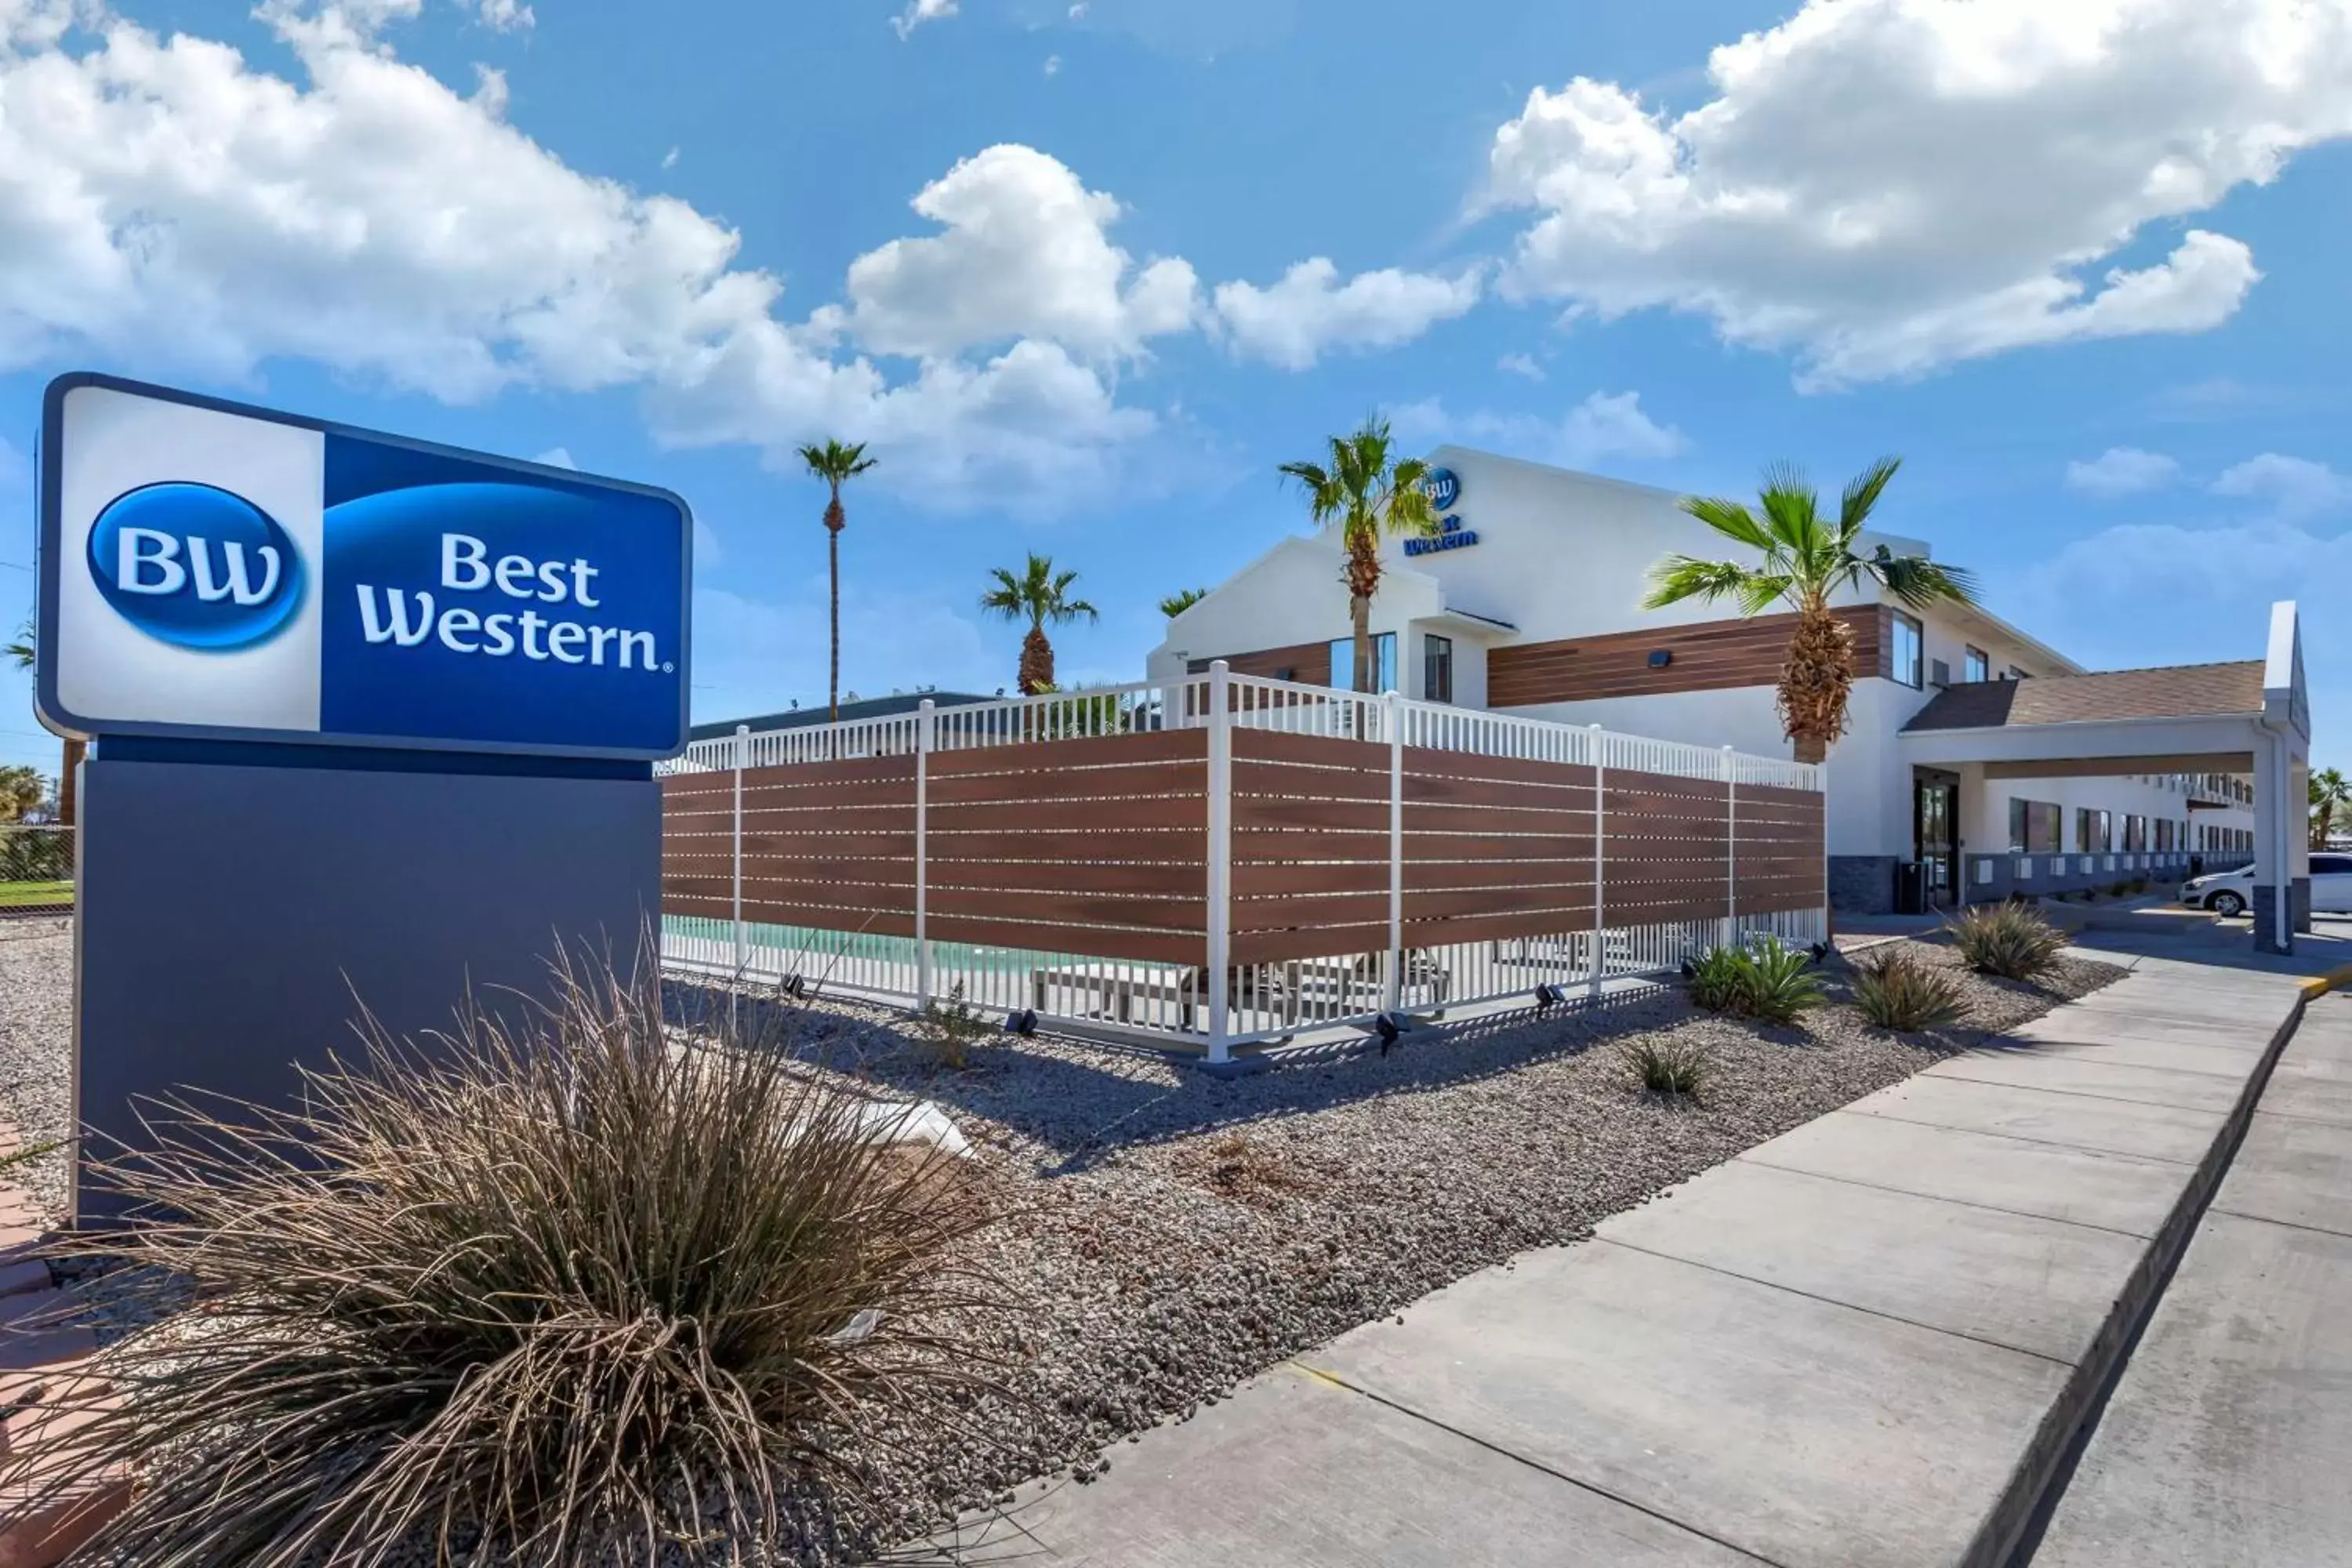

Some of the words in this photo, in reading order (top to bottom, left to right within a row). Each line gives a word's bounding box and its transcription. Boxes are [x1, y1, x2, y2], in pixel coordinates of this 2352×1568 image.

[118, 527, 281, 605] BW
[441, 533, 600, 608] Best
[356, 583, 659, 671] Western
